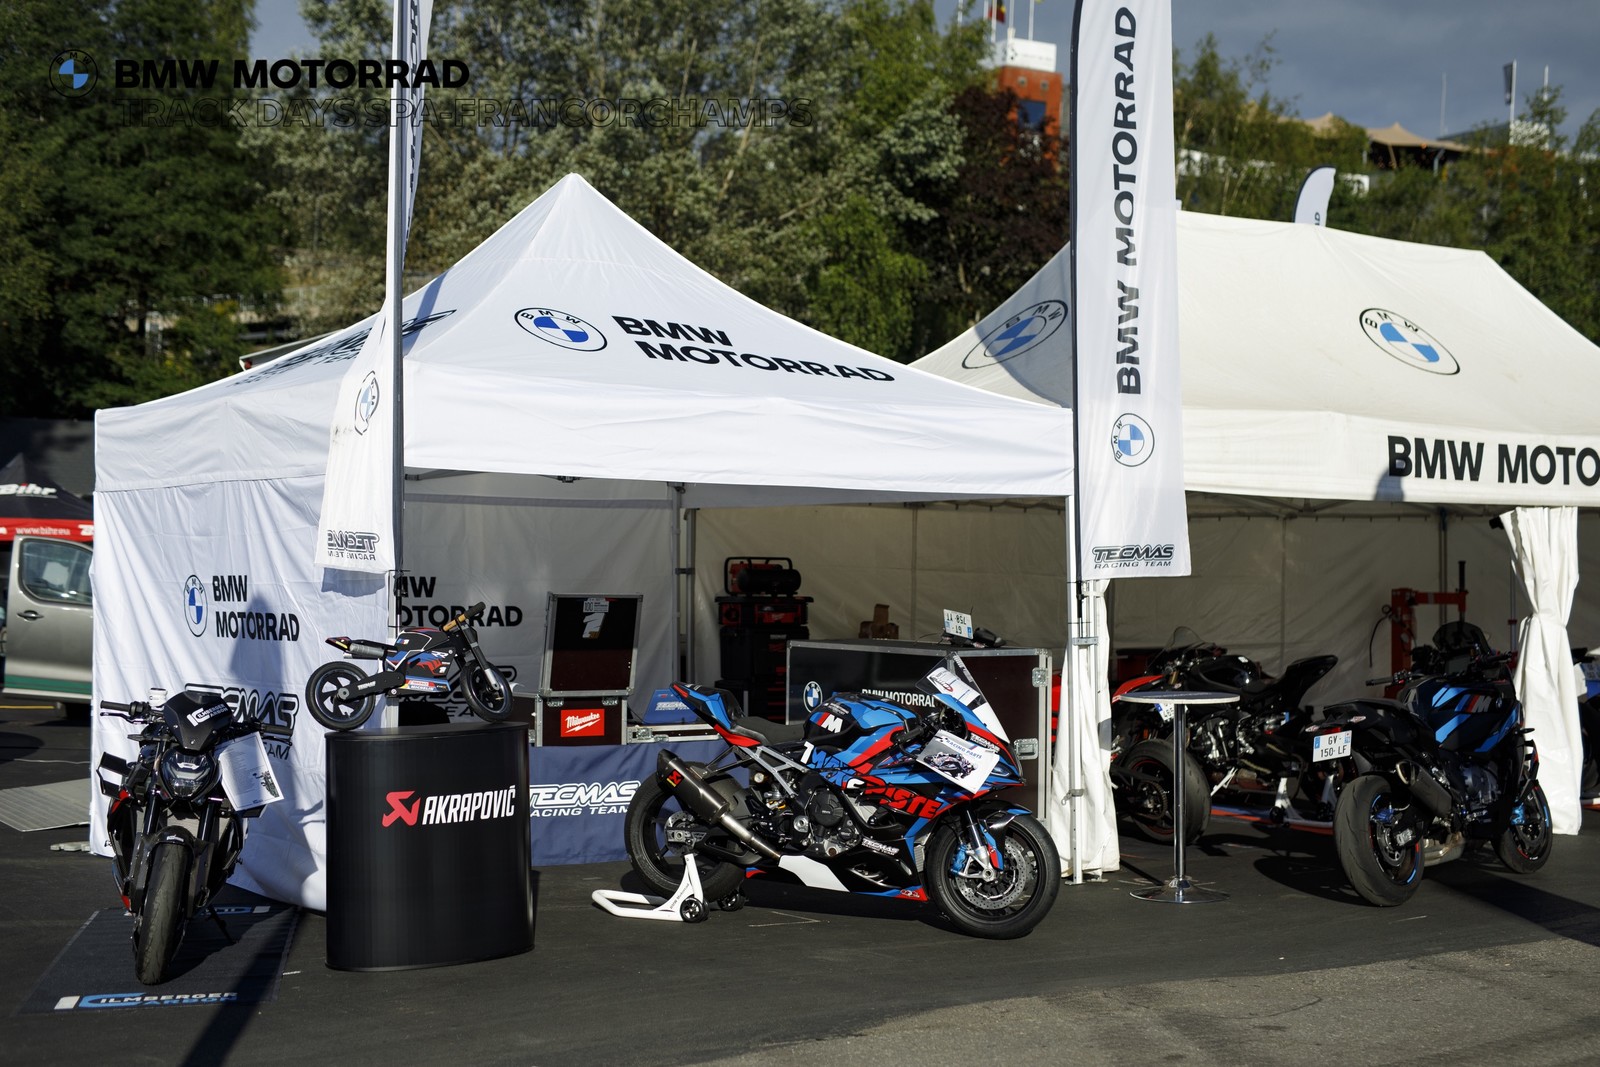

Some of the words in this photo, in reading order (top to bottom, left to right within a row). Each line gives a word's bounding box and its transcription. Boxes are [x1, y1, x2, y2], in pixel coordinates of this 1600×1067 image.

[1111, 6, 1138, 267] MOTORRAD
[611, 315, 733, 347] BMW
[1115, 280, 1141, 395] BMW
[635, 340, 896, 382] MOTORRAD
[1387, 434, 1485, 482] BMW
[1091, 543, 1175, 563] TECMAS
[1094, 560, 1139, 570] RACING
[1143, 560, 1172, 568] TEAM
[212, 574, 248, 602] BMW
[215, 611, 300, 641] MOTORRAD
[564, 712, 601, 729] Milwaukee
